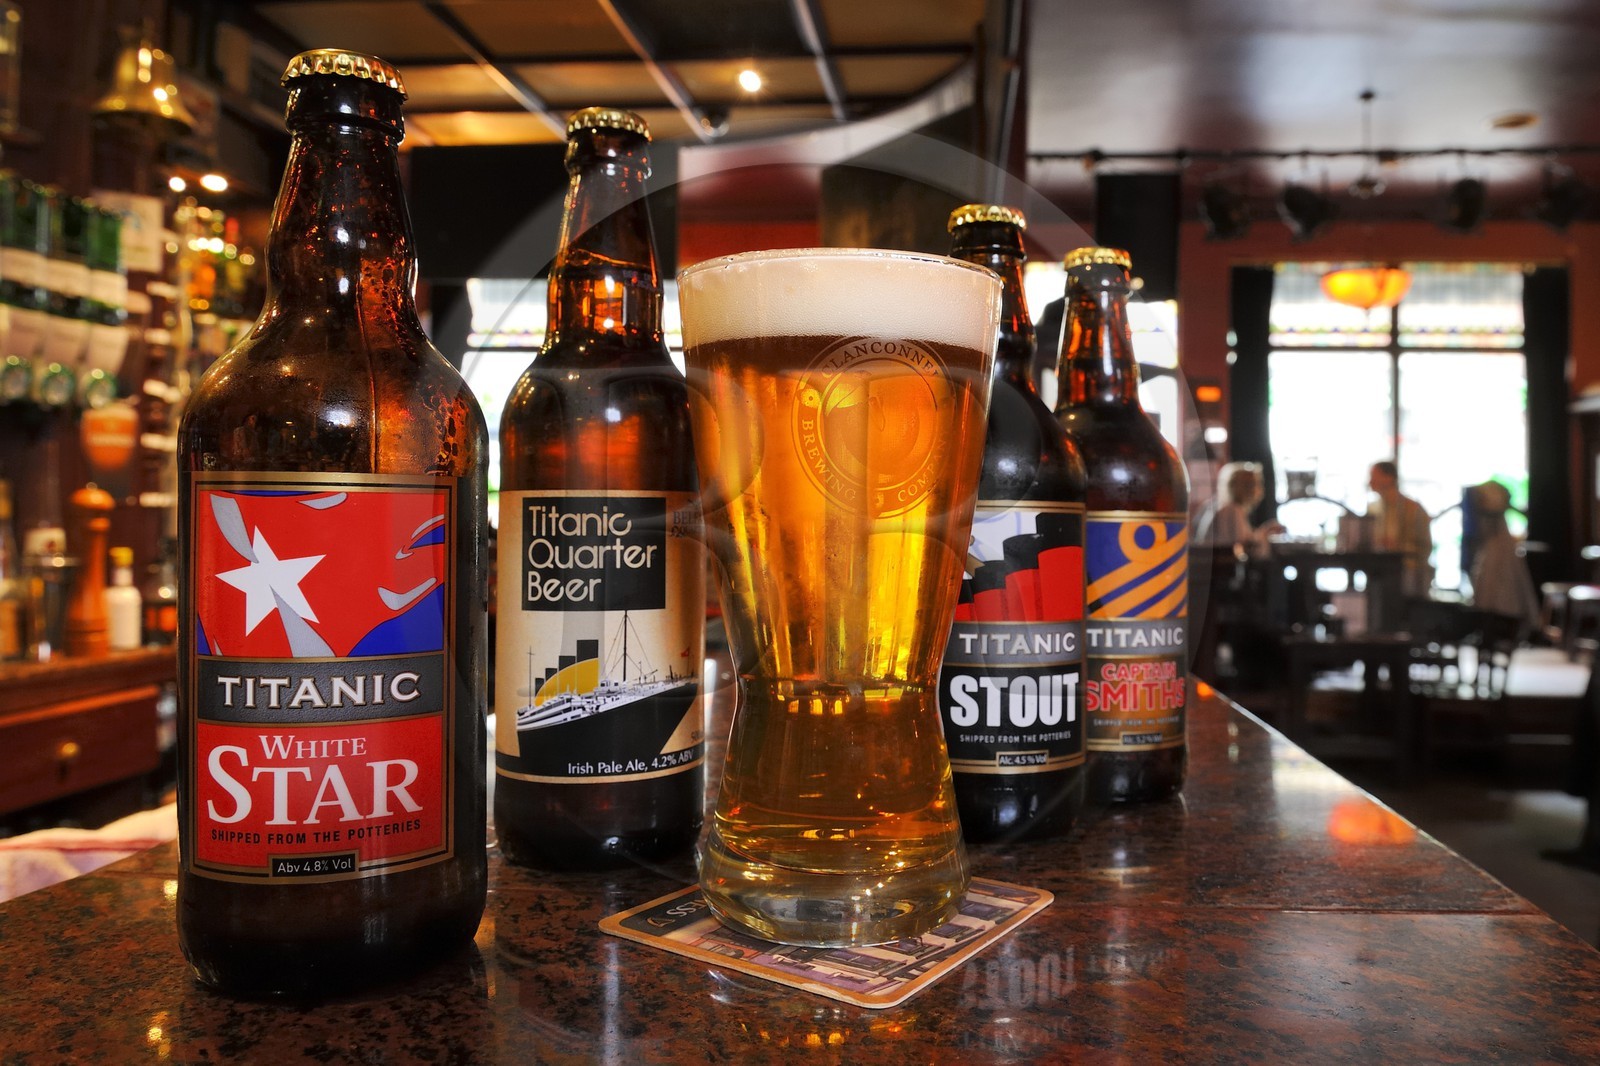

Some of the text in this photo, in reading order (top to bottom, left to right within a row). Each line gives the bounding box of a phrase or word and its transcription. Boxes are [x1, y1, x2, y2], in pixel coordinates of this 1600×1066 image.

[802, 419, 857, 501] BREWING
[529, 505, 632, 536] Titanic
[528, 538, 657, 569] Quarter
[528, 571, 602, 602] Beer
[959, 632, 1076, 655] TITANIC
[1086, 626, 1184, 648] TITANIC
[217, 671, 421, 709] TITANIC
[950, 672, 1079, 728] STOUT
[258, 735, 367, 760] WHITE
[960, 730, 1071, 744] SHIPPED FROM THE POTTERIES
[568, 749, 694, 774] Irish Pale Ale, 4.2% ABV
[207, 744, 424, 825] STAR
[211, 819, 421, 844] SHIPPED FROM THE POTTERIES
[277, 858, 352, 874] Abv 4.8% Vol
